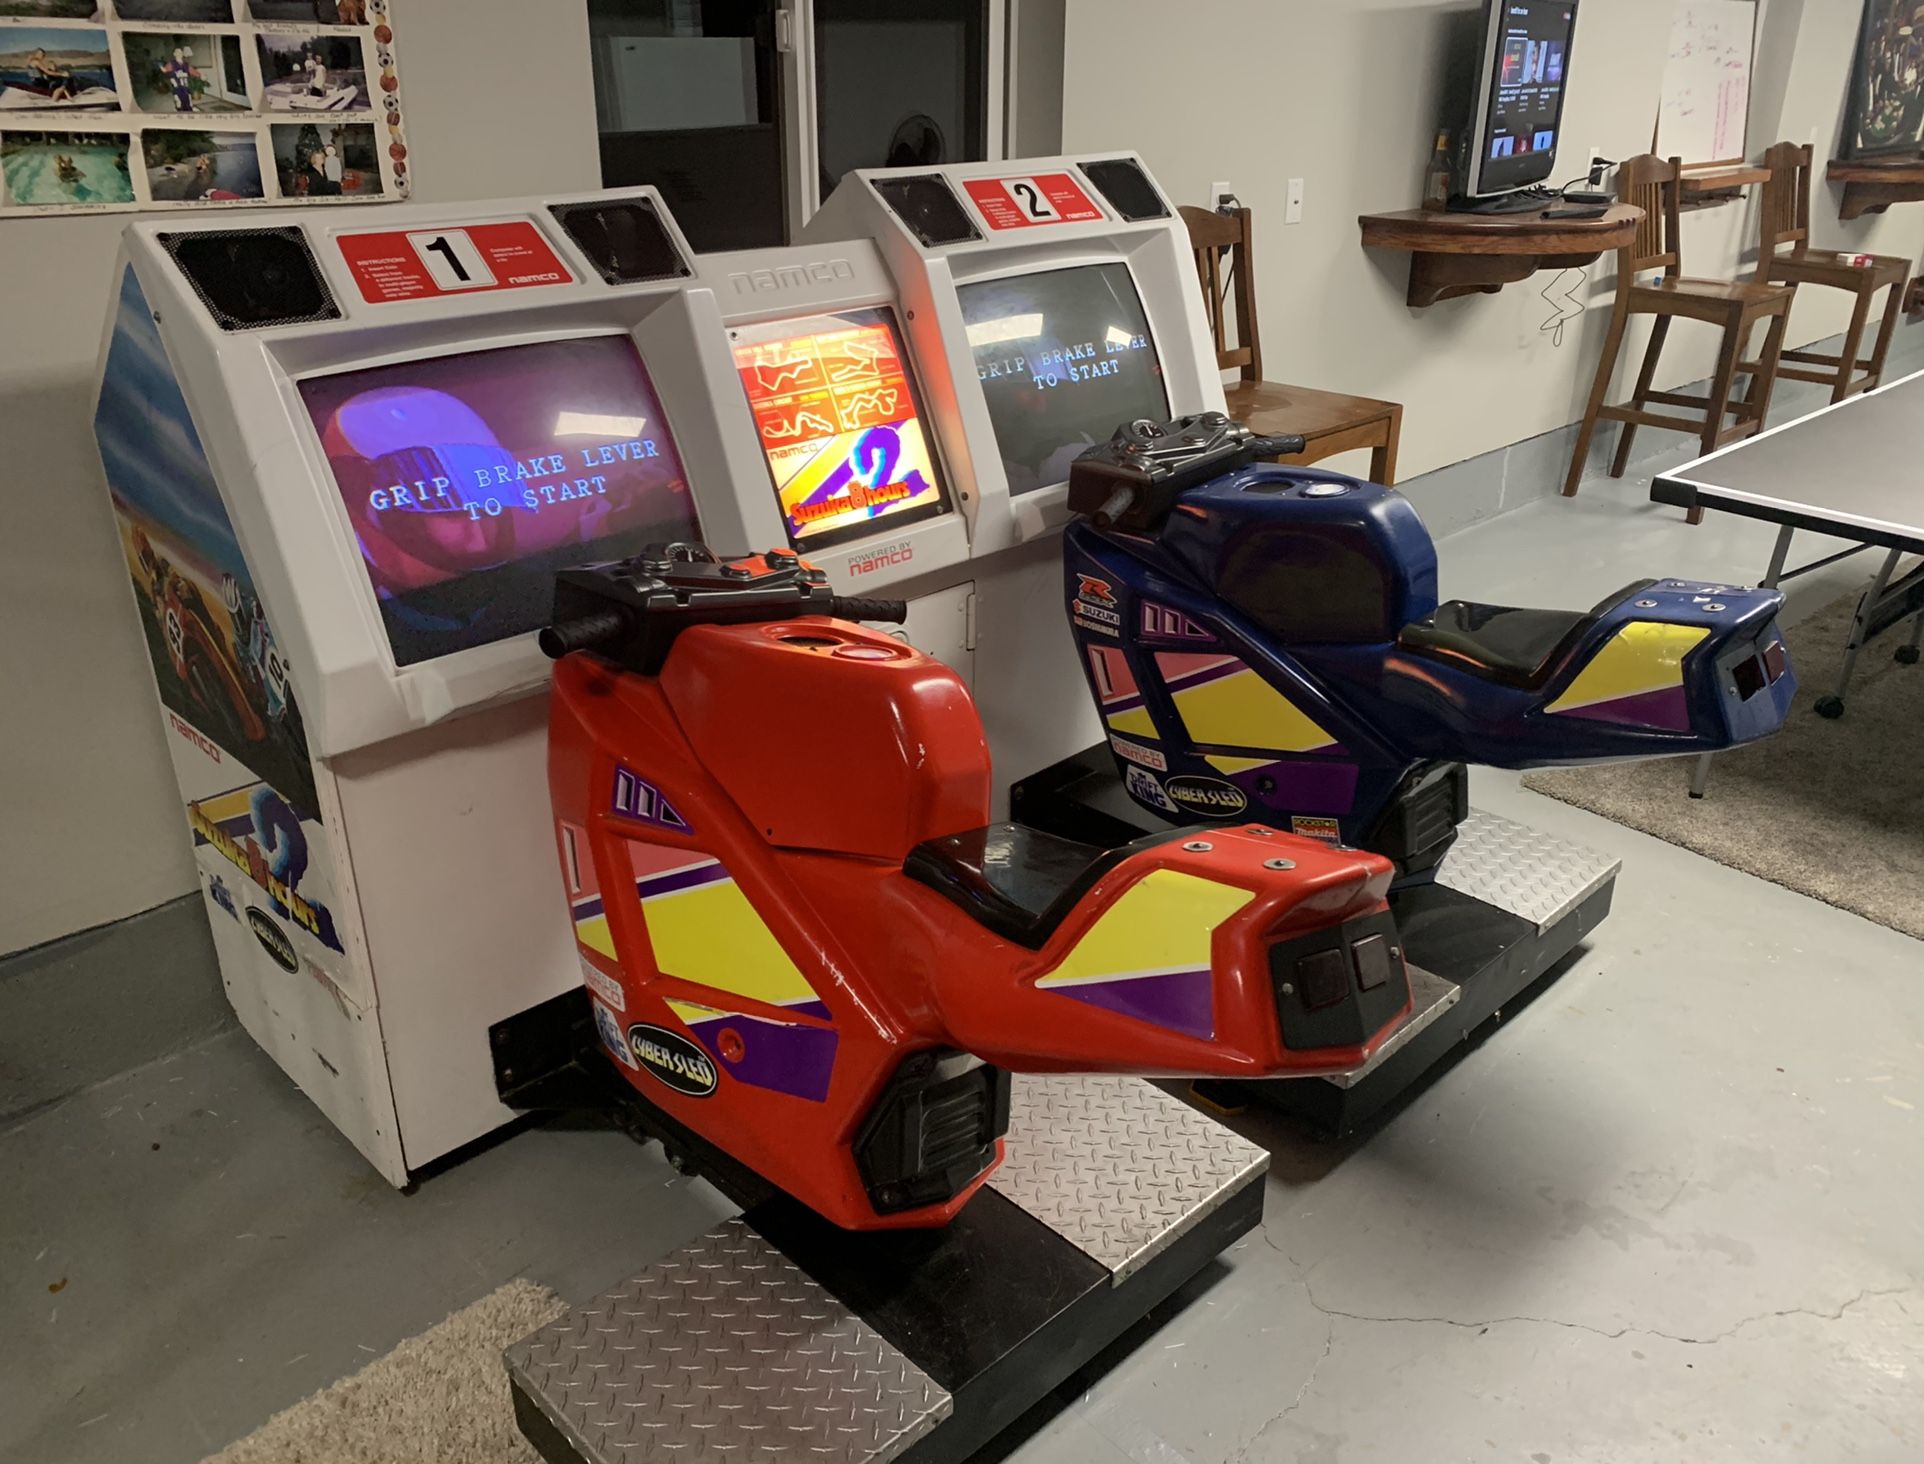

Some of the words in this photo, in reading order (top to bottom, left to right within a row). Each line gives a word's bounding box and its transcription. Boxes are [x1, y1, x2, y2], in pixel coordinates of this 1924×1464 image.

[1014, 183, 1052, 217] 2
[426, 236, 471, 281] 1
[508, 272, 560, 284] namco
[728, 259, 856, 295] namco
[975, 356, 1025, 381] GRIP
[1040, 342, 1096, 366] BRAKE
[1105, 334, 1147, 353] LEER
[1033, 373, 1058, 390] TO
[1070, 359, 1119, 382] START
[769, 442, 819, 461] namco
[370, 477, 451, 511] GRIP
[474, 454, 566, 489] BRAKE
[582, 439, 660, 468] LEVER
[463, 497, 502, 521] TO
[523, 475, 607, 509] START
[848, 545, 897, 564] POWERED
[900, 541, 912, 552] BY
[850, 548, 913, 577] namco
[1082, 605, 1119, 624] SUZUKI
[169, 712, 222, 764] namco
[1169, 785, 1209, 804] CYBER
[1207, 790, 1244, 808] SLED
[631, 1035, 675, 1071] CYBER
[673, 1052, 713, 1087] SLED
